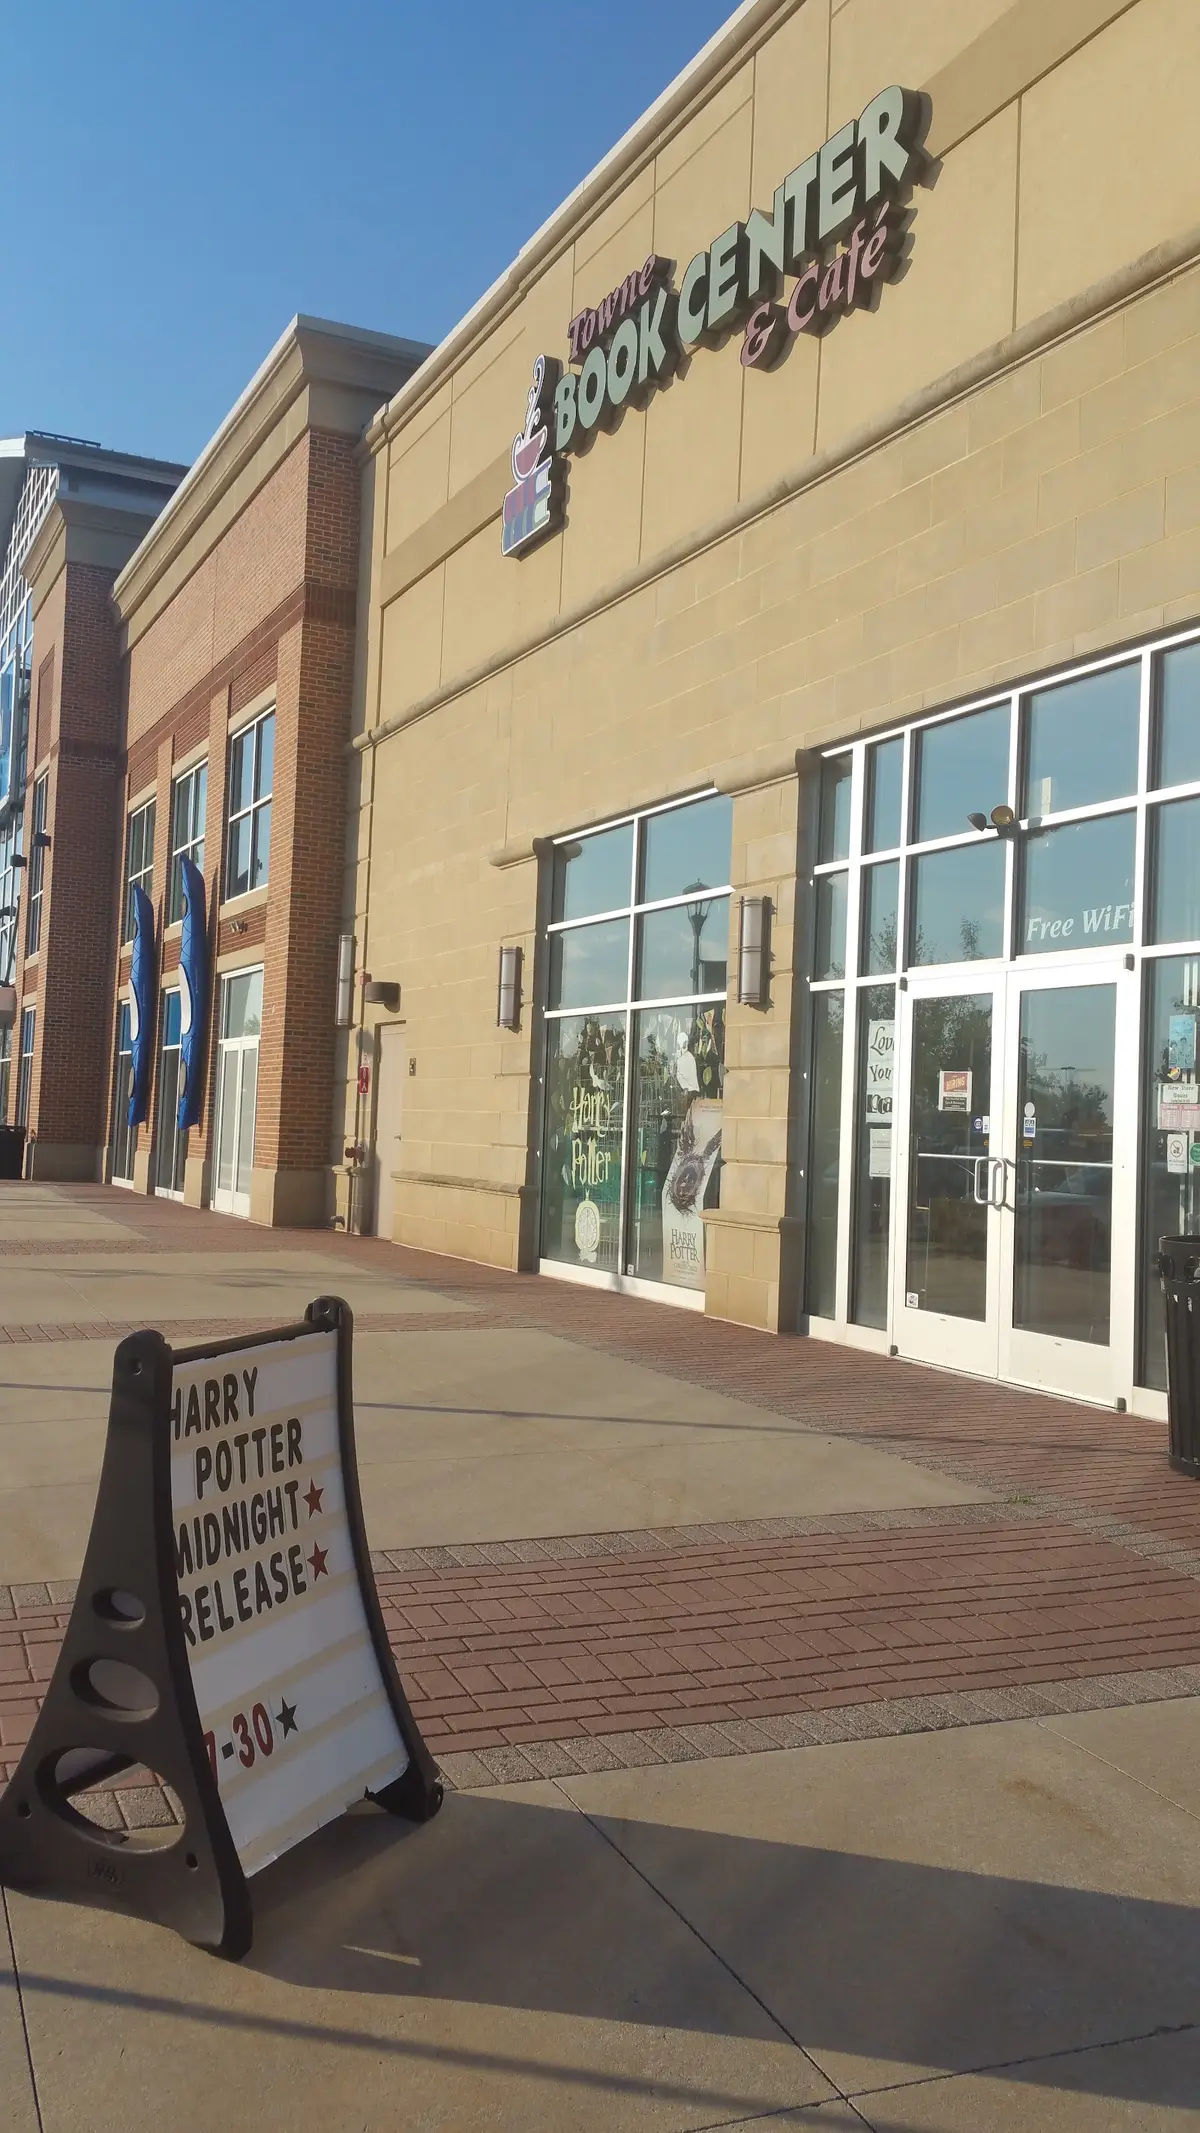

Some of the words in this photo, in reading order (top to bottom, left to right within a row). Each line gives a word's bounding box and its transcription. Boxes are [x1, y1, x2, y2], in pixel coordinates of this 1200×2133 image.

[556, 287, 668, 452] BOOK
[677, 85, 910, 345] CENTER
[740, 302, 776, 367] &
[787, 201, 890, 332] Café
[568, 254, 656, 361] Towne
[1026, 917, 1074, 942] Free
[1082, 901, 1135, 934] WiFi
[870, 1026, 895, 1056] Lov
[569, 1087, 611, 1138] Harry
[571, 1137, 612, 1190] Potter
[669, 1242, 700, 1263] POTTER
[671, 1228, 697, 1248] HARRY
[195, 1417, 303, 1500] POTTER
[178, 1544, 307, 1647] RELEASE
